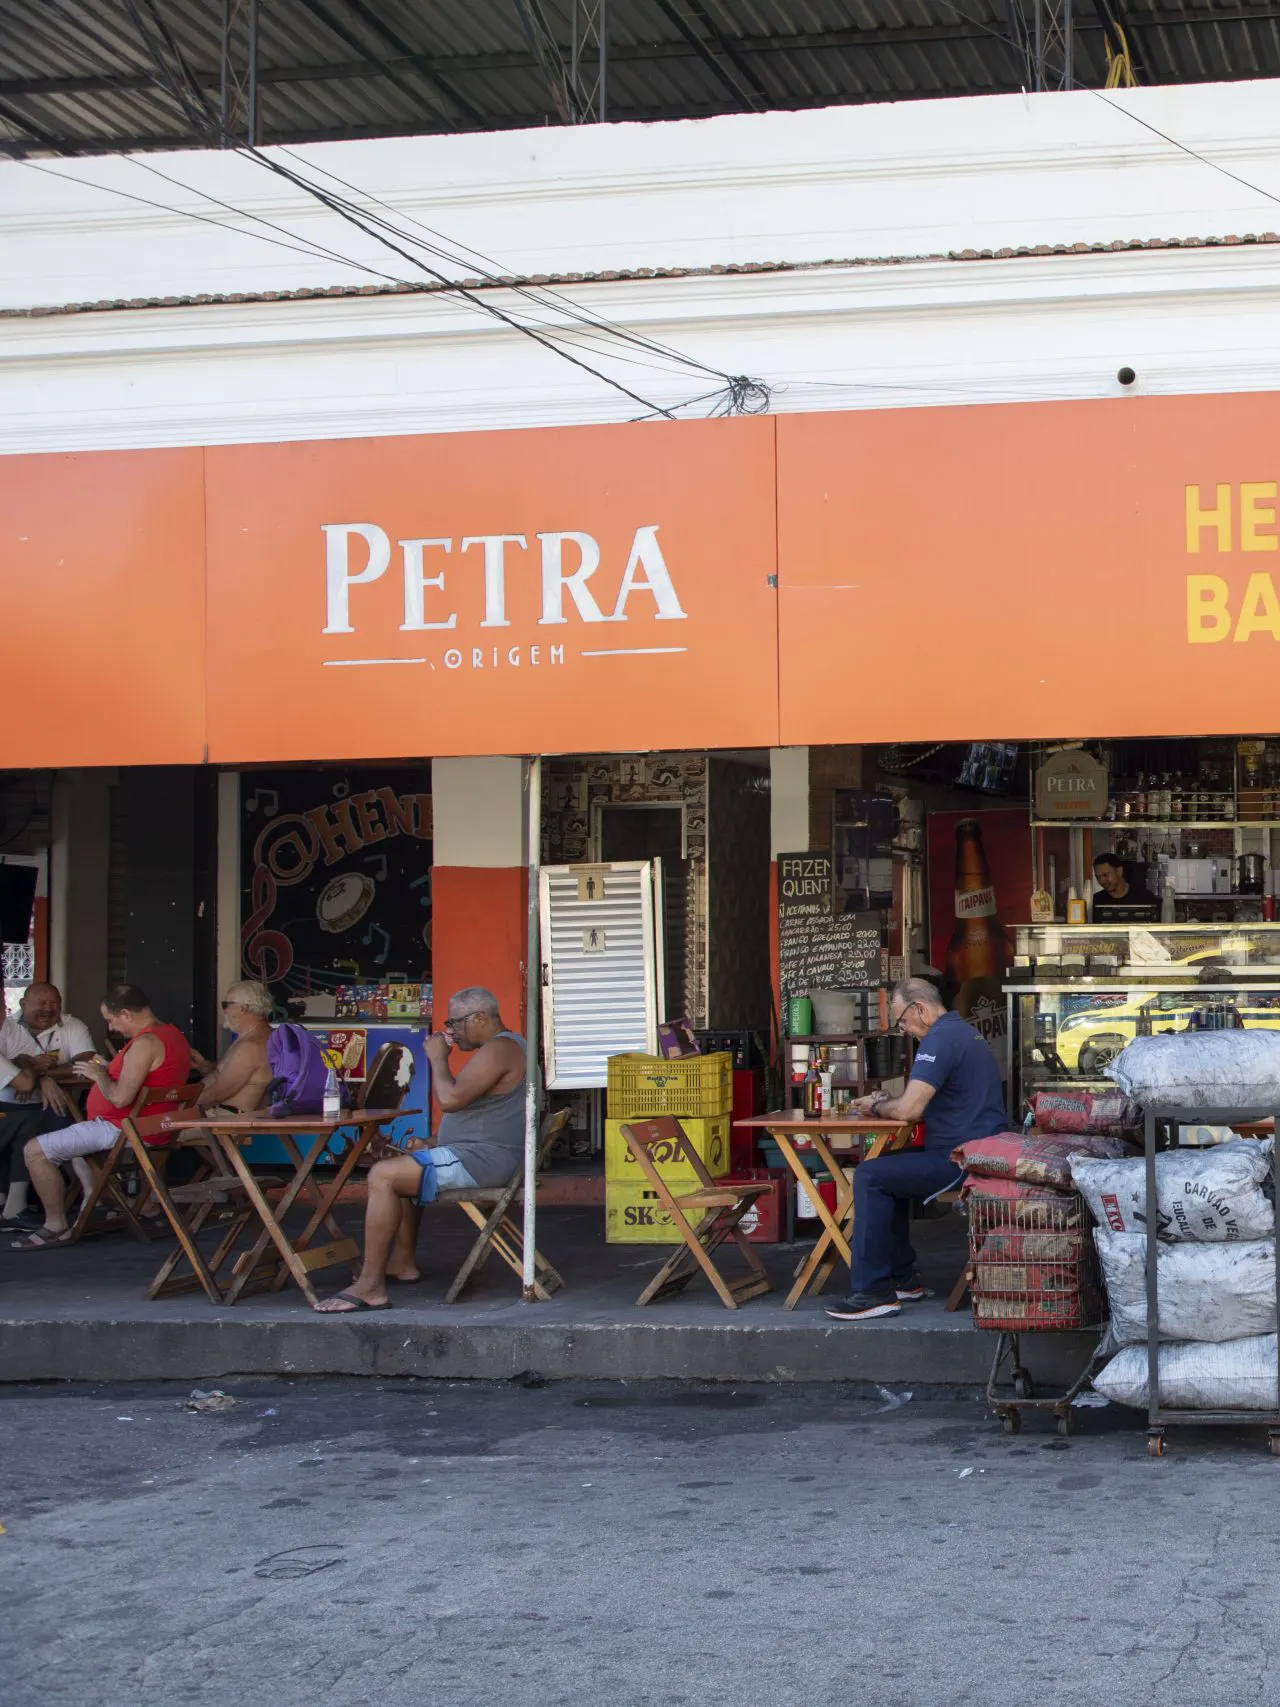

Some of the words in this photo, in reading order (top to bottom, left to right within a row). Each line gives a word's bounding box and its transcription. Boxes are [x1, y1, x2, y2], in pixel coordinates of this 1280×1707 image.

[320, 522, 689, 634] PETRA
[1047, 777, 1096, 792] PETRA
[783, 879, 830, 898] QUENT
[624, 1206, 677, 1226] SKO
[1202, 1216, 1217, 1231] DE
